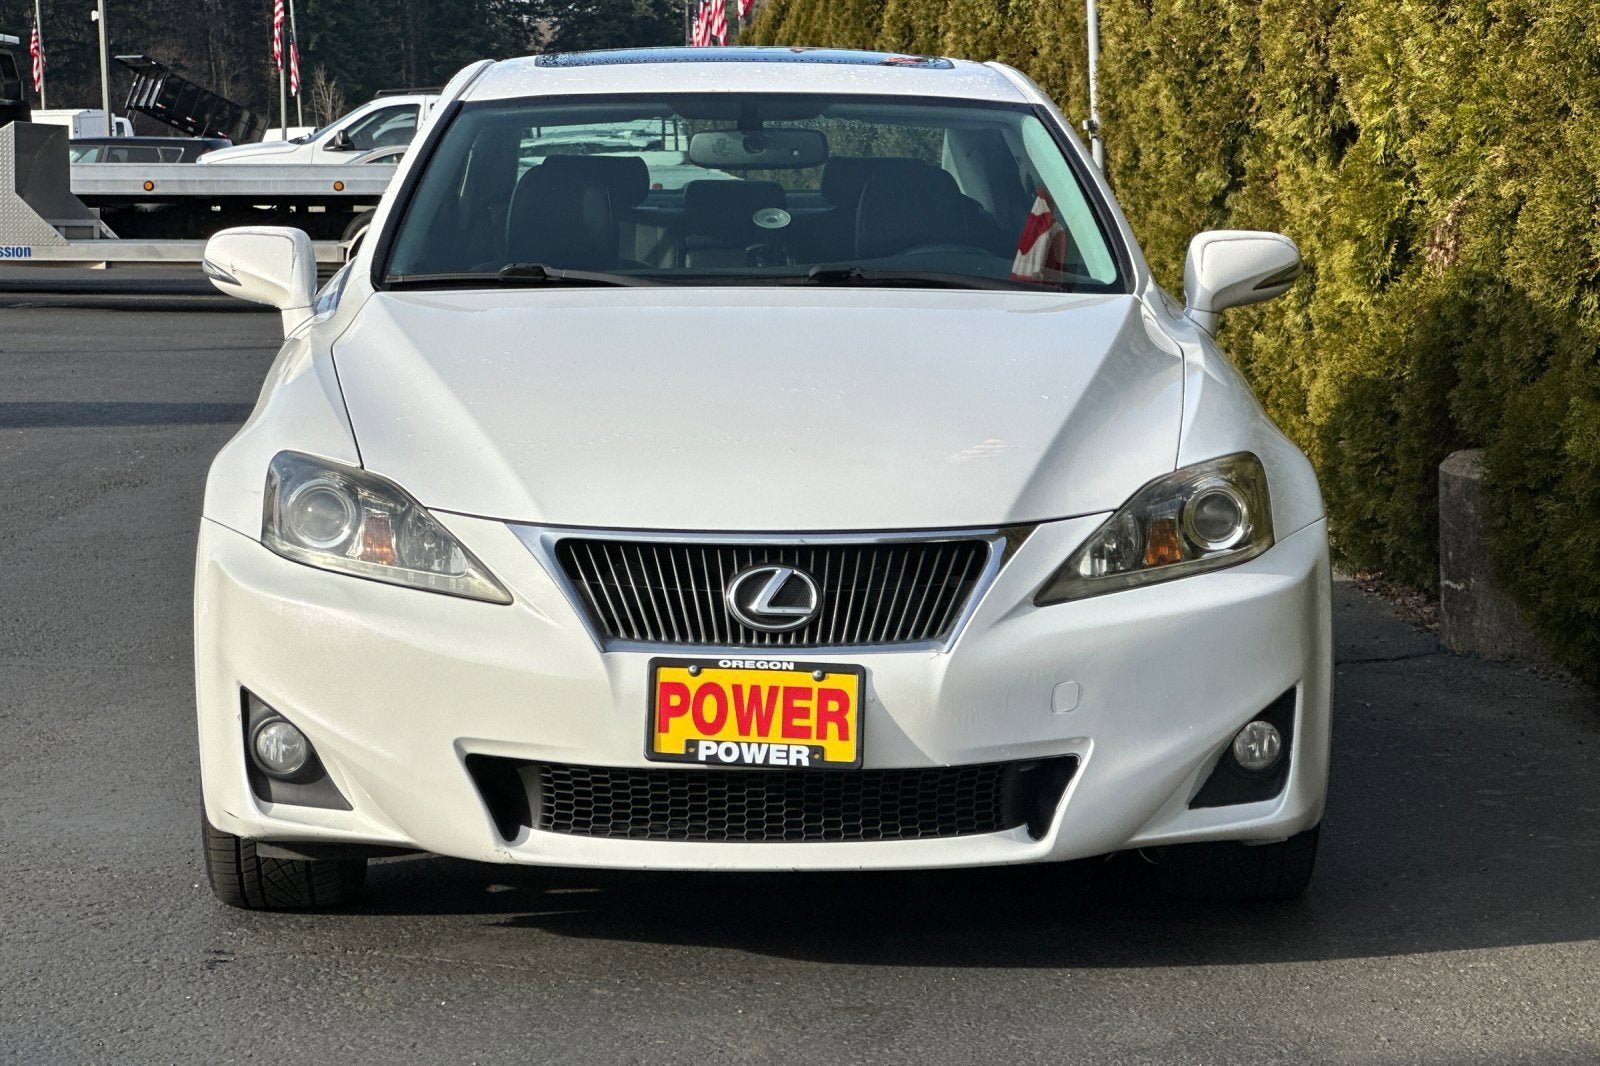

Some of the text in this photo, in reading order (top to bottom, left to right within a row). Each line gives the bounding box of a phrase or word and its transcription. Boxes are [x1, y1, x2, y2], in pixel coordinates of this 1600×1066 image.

[718, 659, 795, 671] OREGON
[657, 681, 850, 742] POWER
[697, 740, 810, 767] POWER
